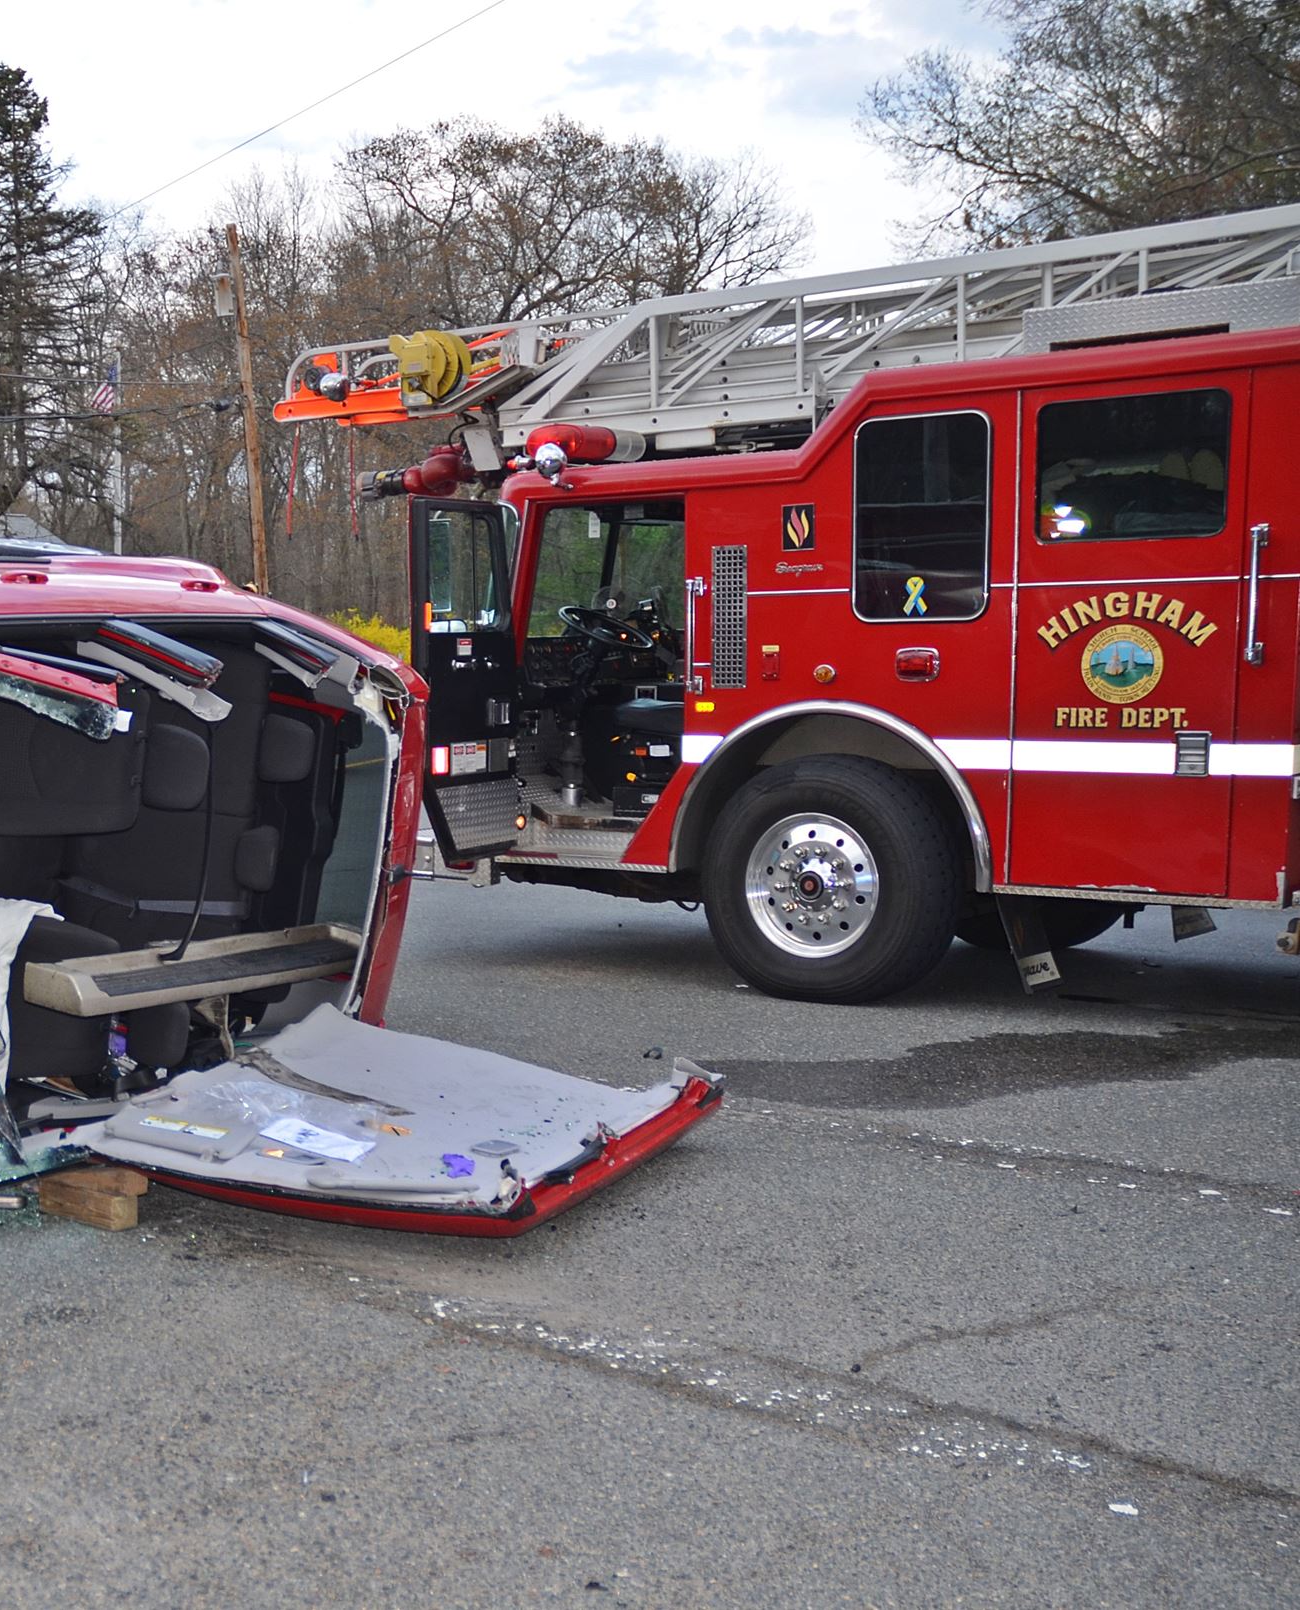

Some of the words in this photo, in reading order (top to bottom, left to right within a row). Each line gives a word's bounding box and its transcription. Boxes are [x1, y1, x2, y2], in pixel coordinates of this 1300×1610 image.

[1037, 591, 1218, 648] HINGHAM
[1056, 707, 1108, 728] FIRE
[1121, 707, 1189, 728] DEPT.
